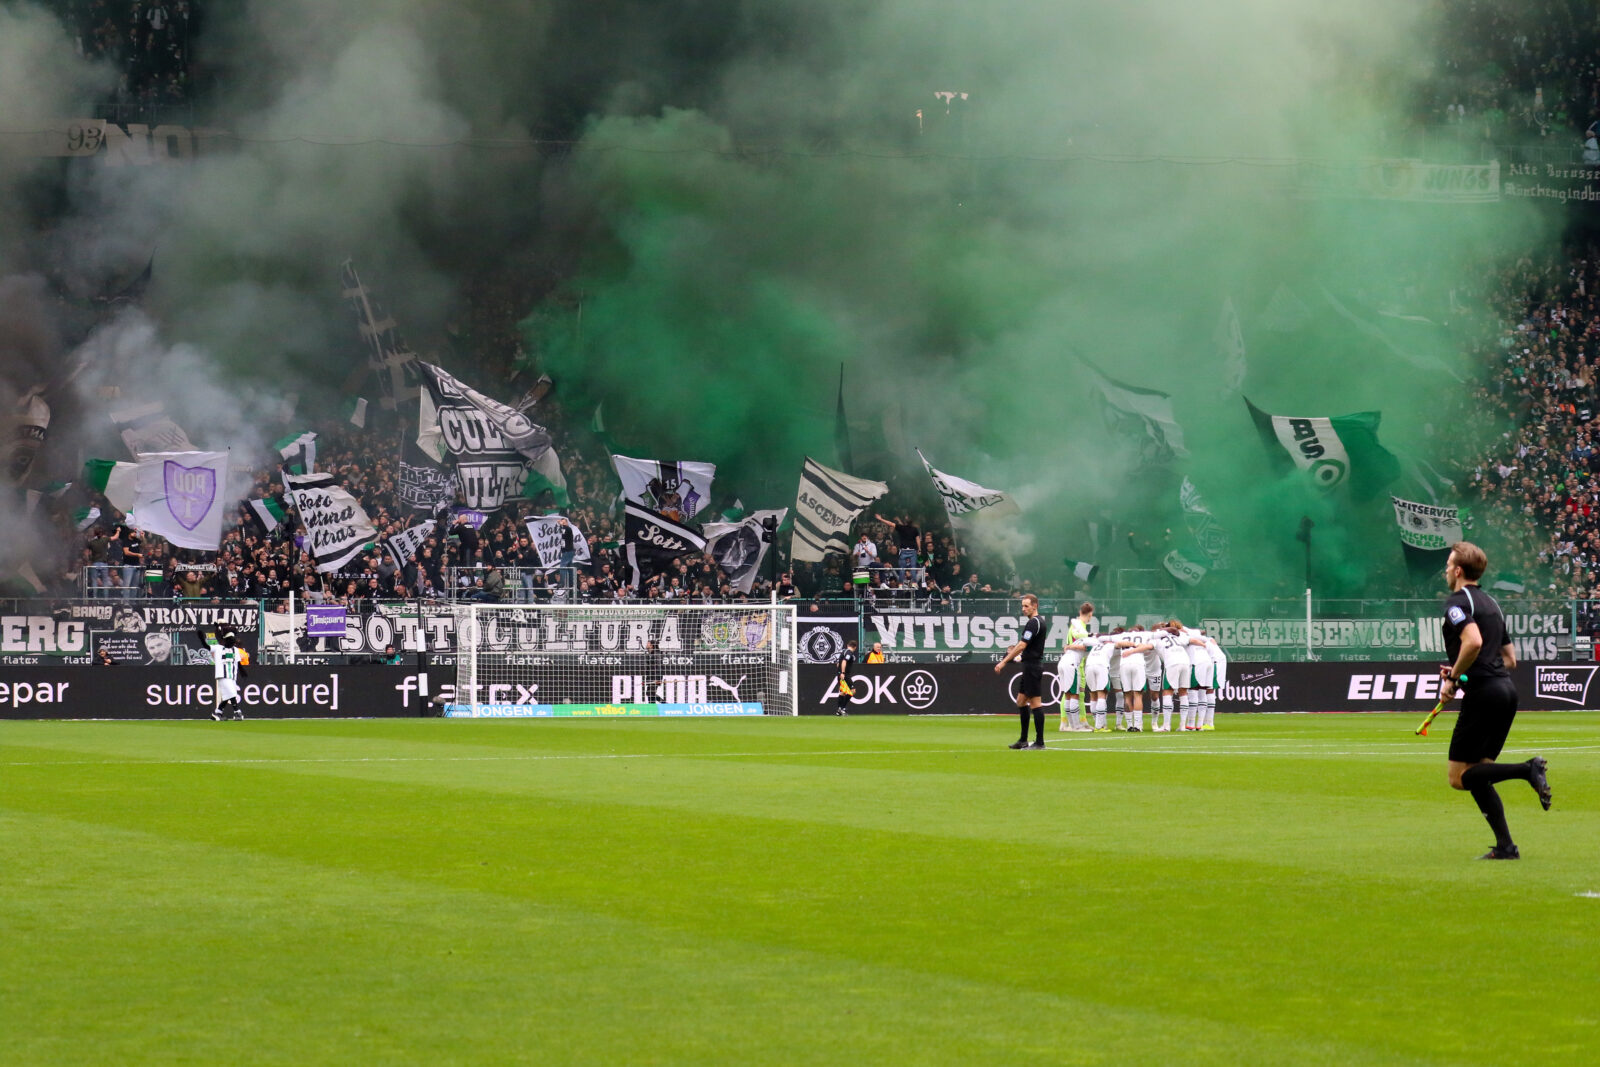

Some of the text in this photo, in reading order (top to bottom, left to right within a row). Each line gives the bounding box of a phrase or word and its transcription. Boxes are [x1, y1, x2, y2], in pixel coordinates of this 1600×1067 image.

[143, 607, 259, 626] FRONTLINE
[2, 655, 39, 665] flatex
[578, 655, 622, 665] flatex
[720, 655, 764, 665] flatex
[1540, 670, 1569, 682] inter
[1541, 681, 1583, 692] wetten
[0, 682, 70, 708] epar
[685, 703, 744, 715] JONGEN
